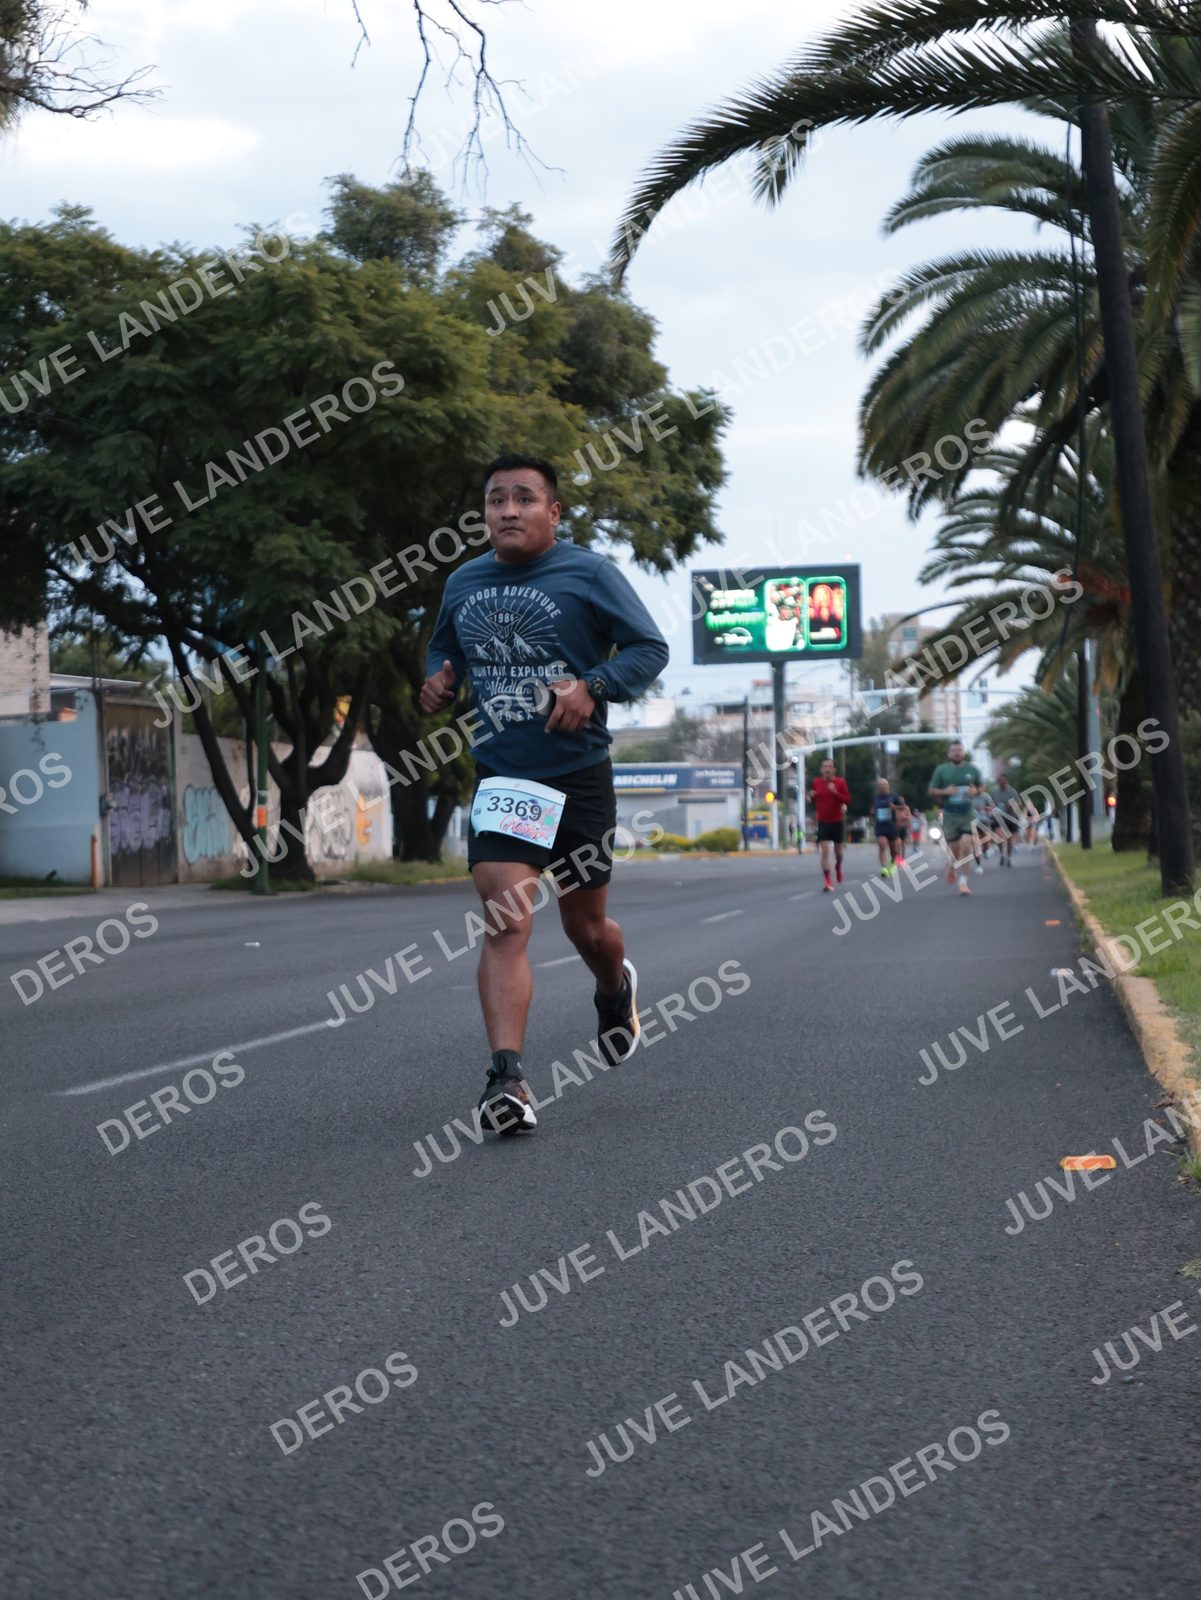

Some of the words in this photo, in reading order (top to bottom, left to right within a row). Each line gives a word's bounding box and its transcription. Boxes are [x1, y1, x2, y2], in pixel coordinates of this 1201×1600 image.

[459, 587, 497, 622] OUTDOOR
[503, 585, 562, 618] ADVENTURE
[613, 774, 677, 786] MICHELIN
[487, 796, 542, 821] 3369
